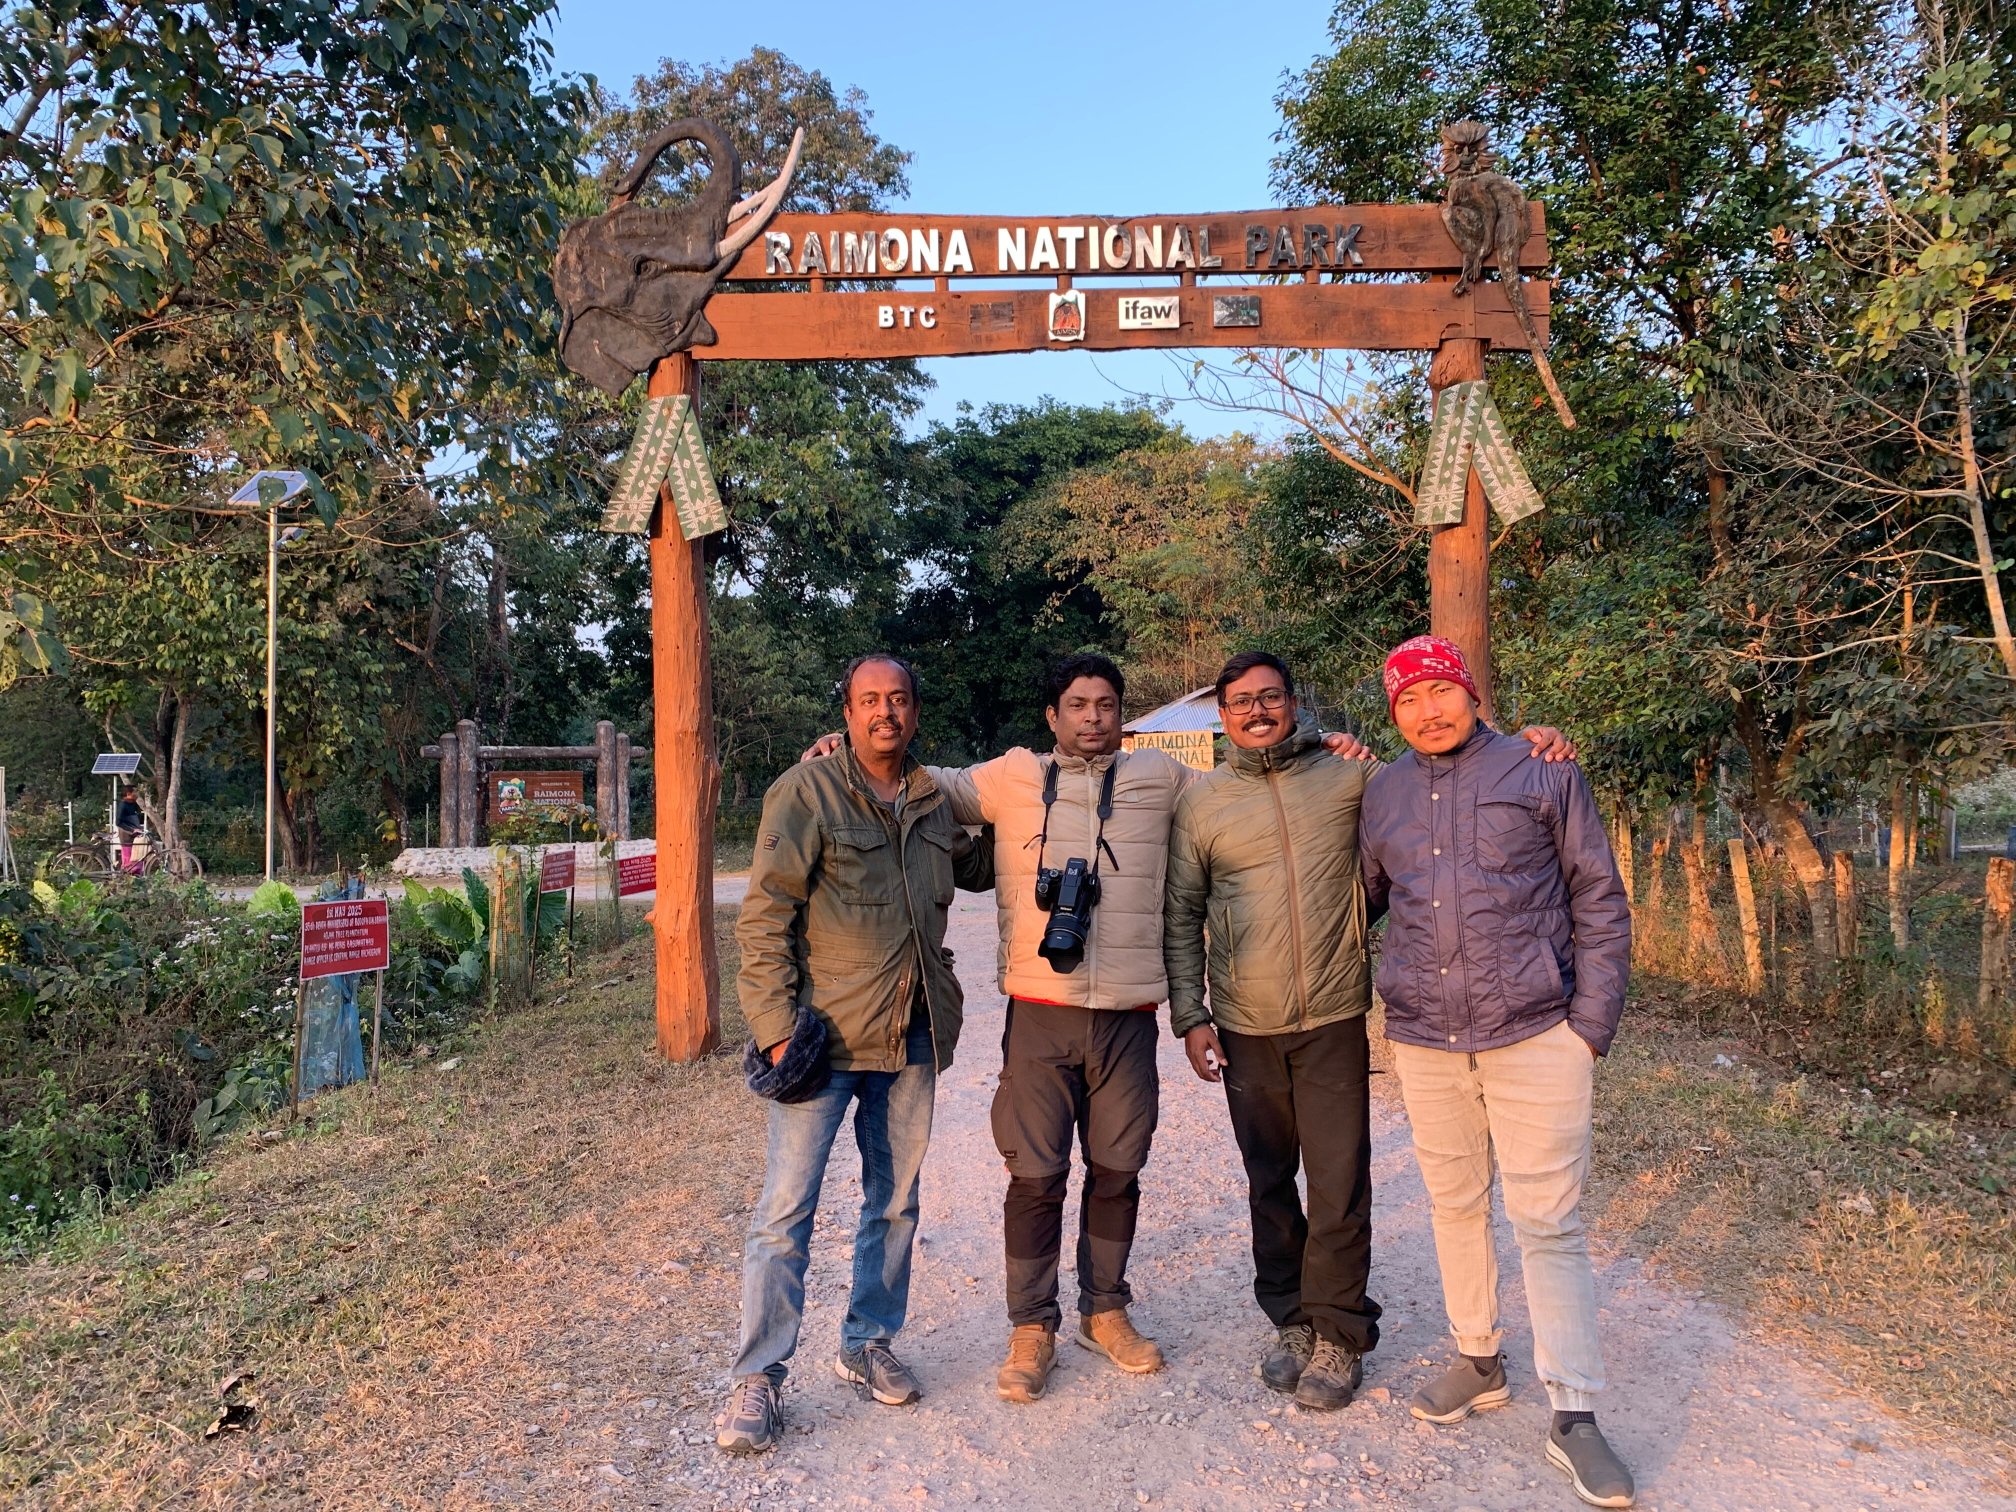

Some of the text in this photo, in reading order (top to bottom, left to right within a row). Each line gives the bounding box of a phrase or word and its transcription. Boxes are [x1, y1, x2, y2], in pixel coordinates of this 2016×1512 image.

[764, 223, 1364, 275] RAIMONA NATIONAL PARK
[878, 305, 936, 329] BTC
[1125, 300, 1174, 320] ifaw
[1137, 733, 1209, 750] RAIMONA
[534, 790, 577, 798] RAIMONA
[335, 906, 346, 917] MAY
[348, 905, 363, 916] 2025
